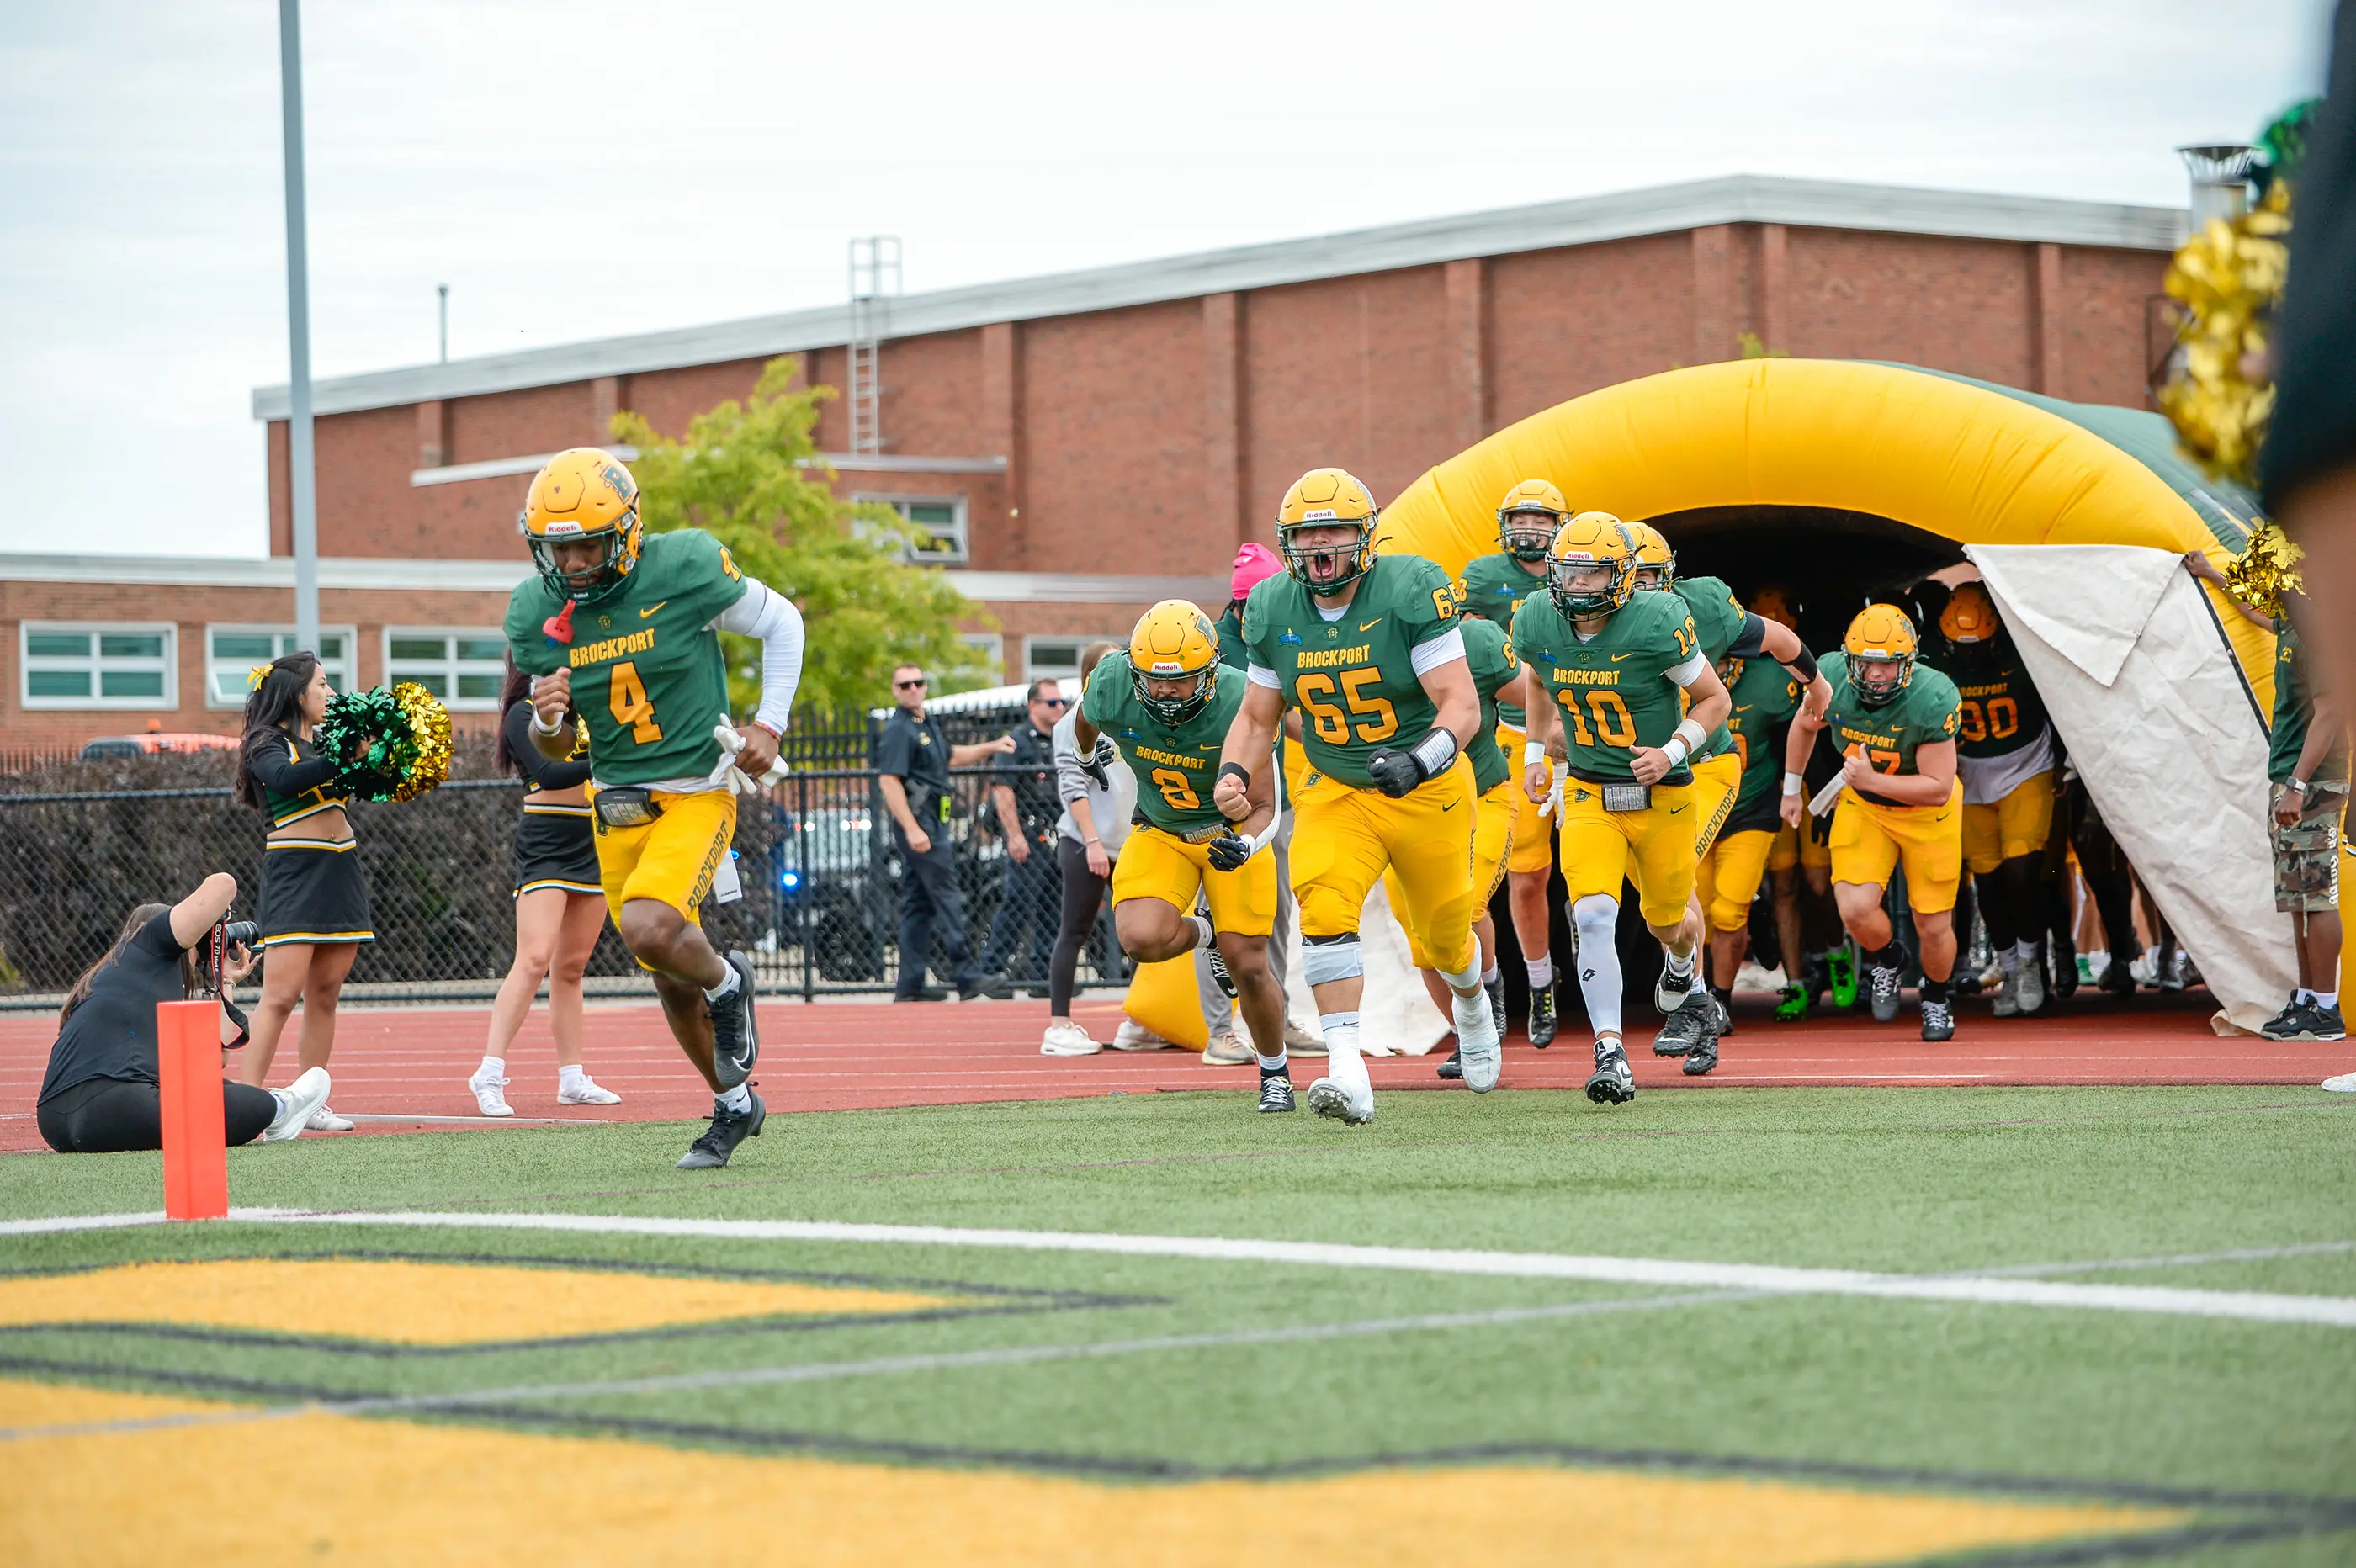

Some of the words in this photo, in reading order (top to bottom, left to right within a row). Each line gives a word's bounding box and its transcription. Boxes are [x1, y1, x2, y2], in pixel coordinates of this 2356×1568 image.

[600, 464, 633, 504] B
[718, 546, 741, 583] 4
[570, 628, 655, 668] BROCKPORT
[1297, 644, 1370, 668] BROCKPORT
[1673, 615, 1697, 658] 10
[1553, 668, 1620, 685] BROCKPORT
[1960, 682, 2008, 697] ROCKPORT
[609, 660, 664, 745] 4
[1294, 665, 1400, 745] 65
[1557, 688, 1638, 747] 10
[1961, 697, 2019, 742] 90
[1136, 745, 1206, 769] BROCKPORT
[1841, 727, 1896, 749] BROCKPORT
[1842, 742, 1901, 775] 7
[1695, 787, 1737, 858] BROCKPORT
[687, 819, 730, 913] BROCKPORT
[214, 945, 220, 955] 7D
